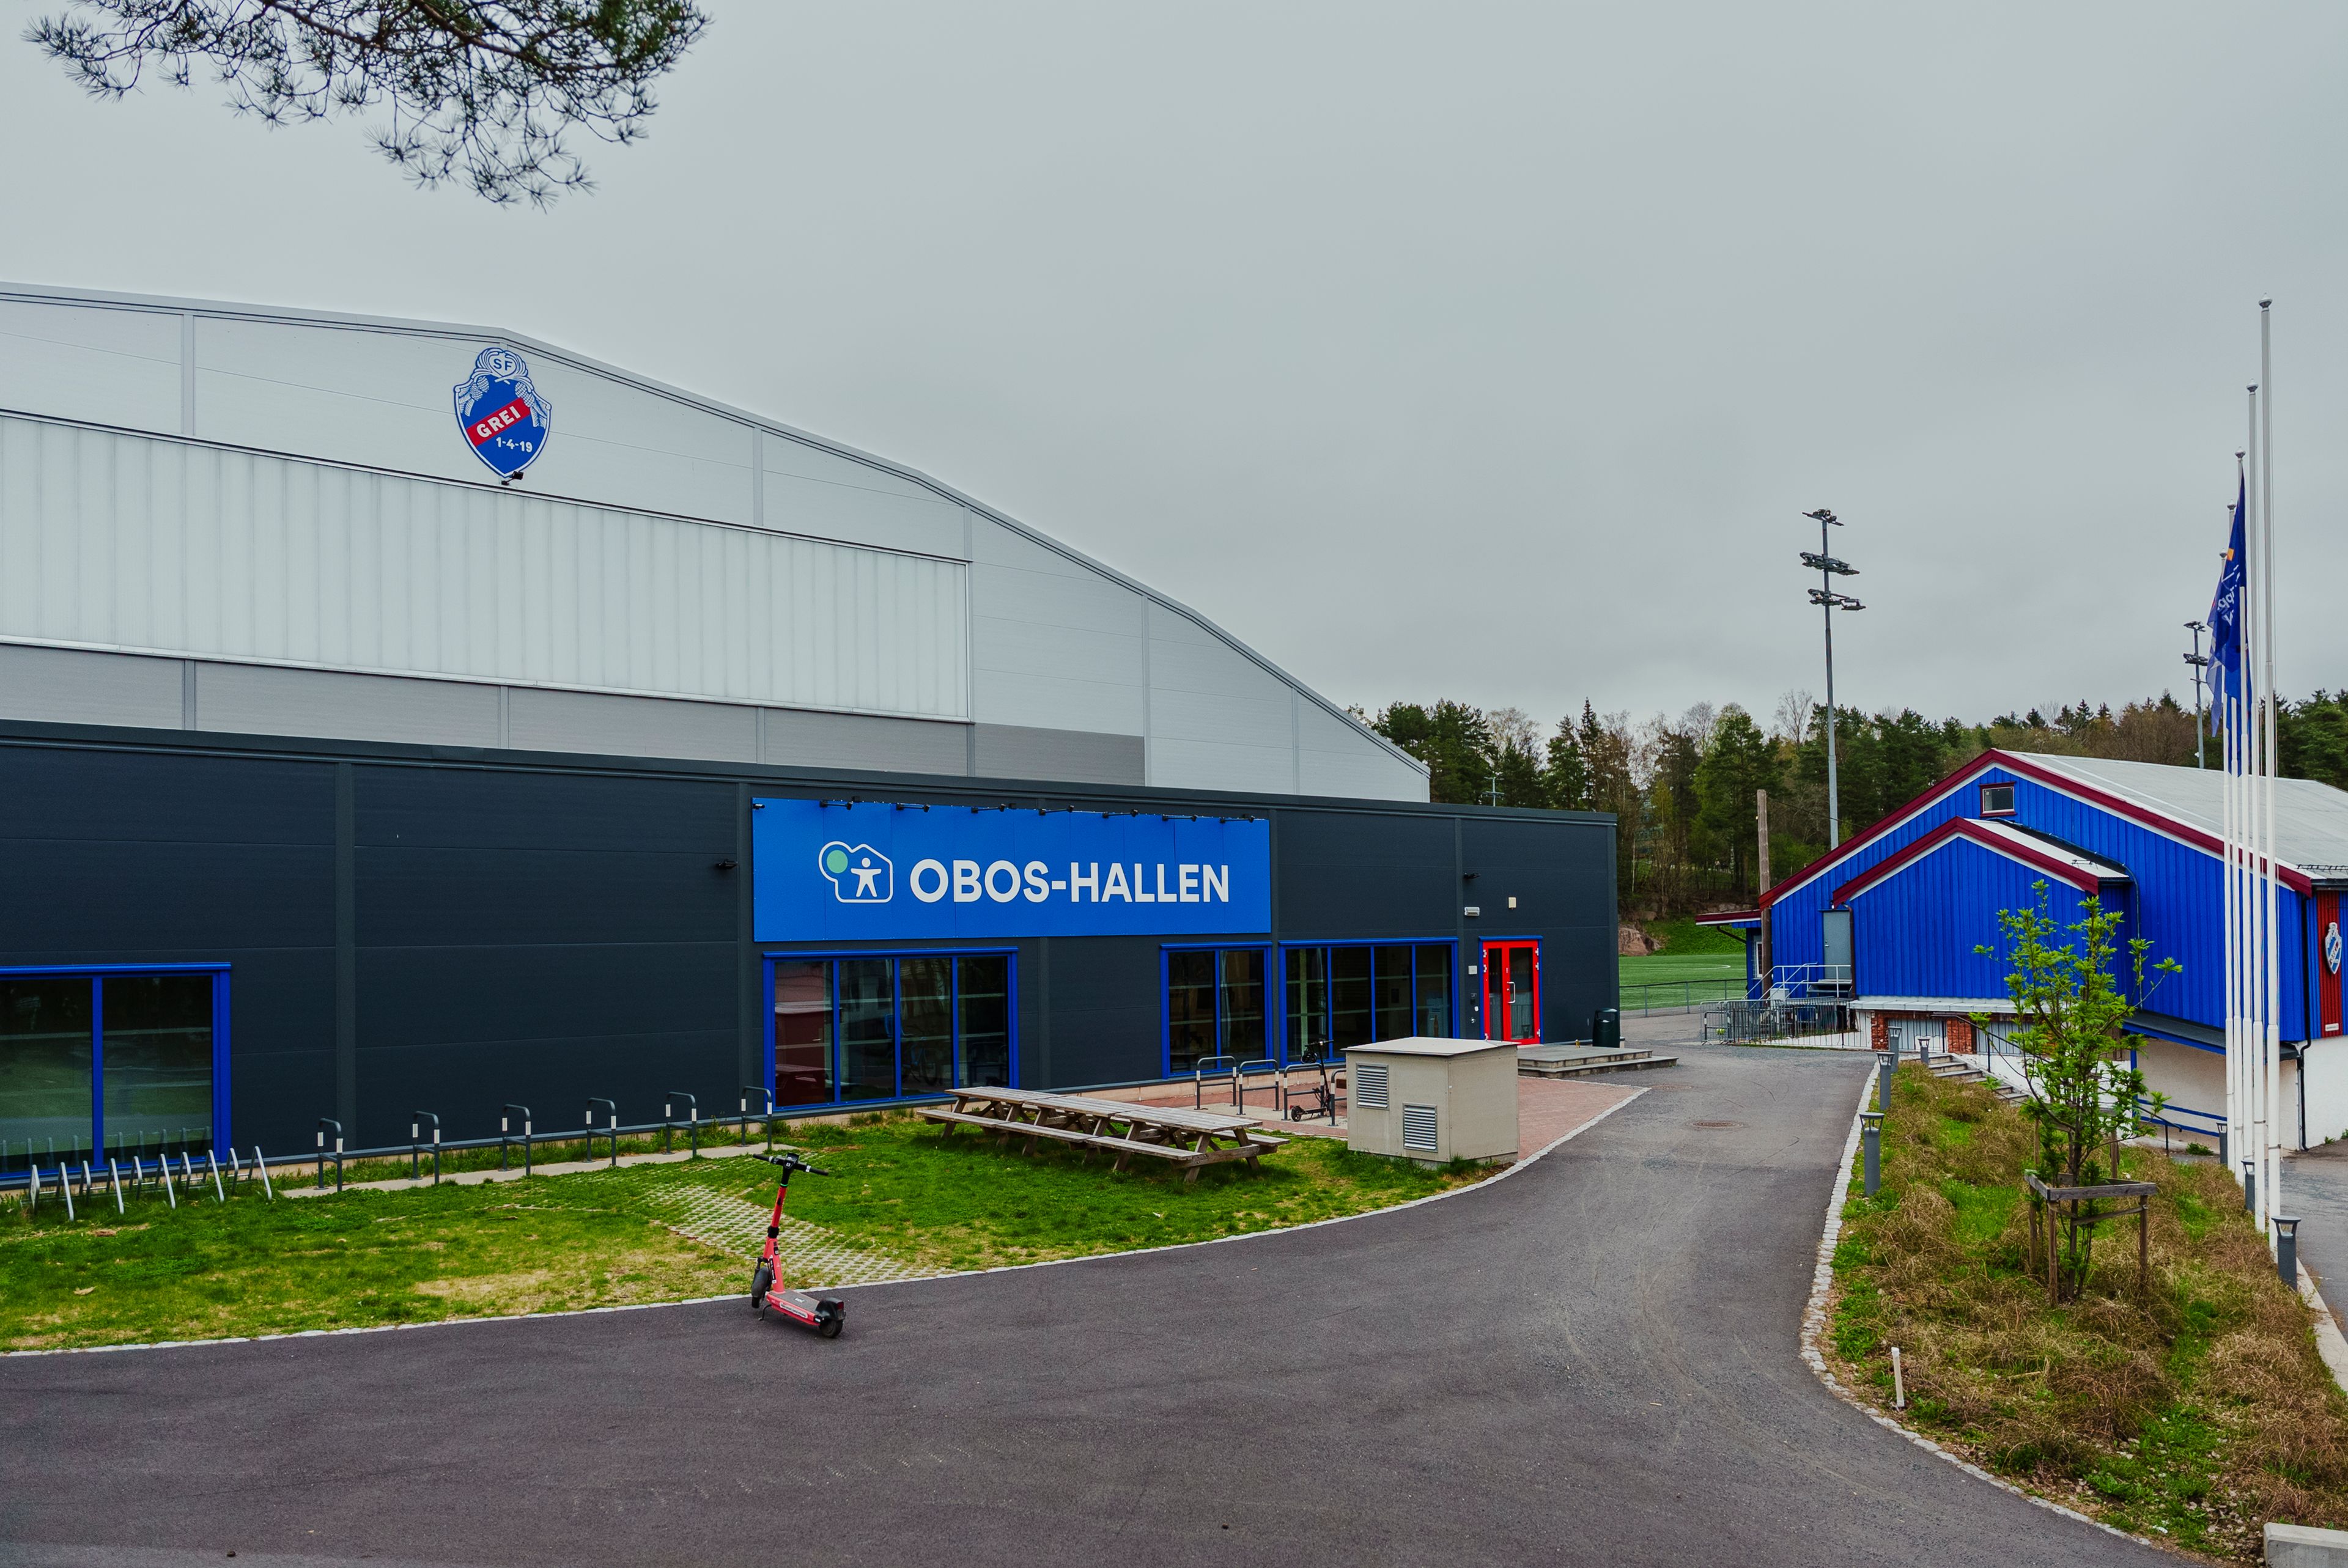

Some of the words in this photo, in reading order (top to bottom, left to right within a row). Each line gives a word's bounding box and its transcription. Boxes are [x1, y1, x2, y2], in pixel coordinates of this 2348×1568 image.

[476, 406, 521, 438] GREI
[496, 437, 533, 452] 1-4-19
[910, 859, 1229, 903] OBOS-HALLEN
